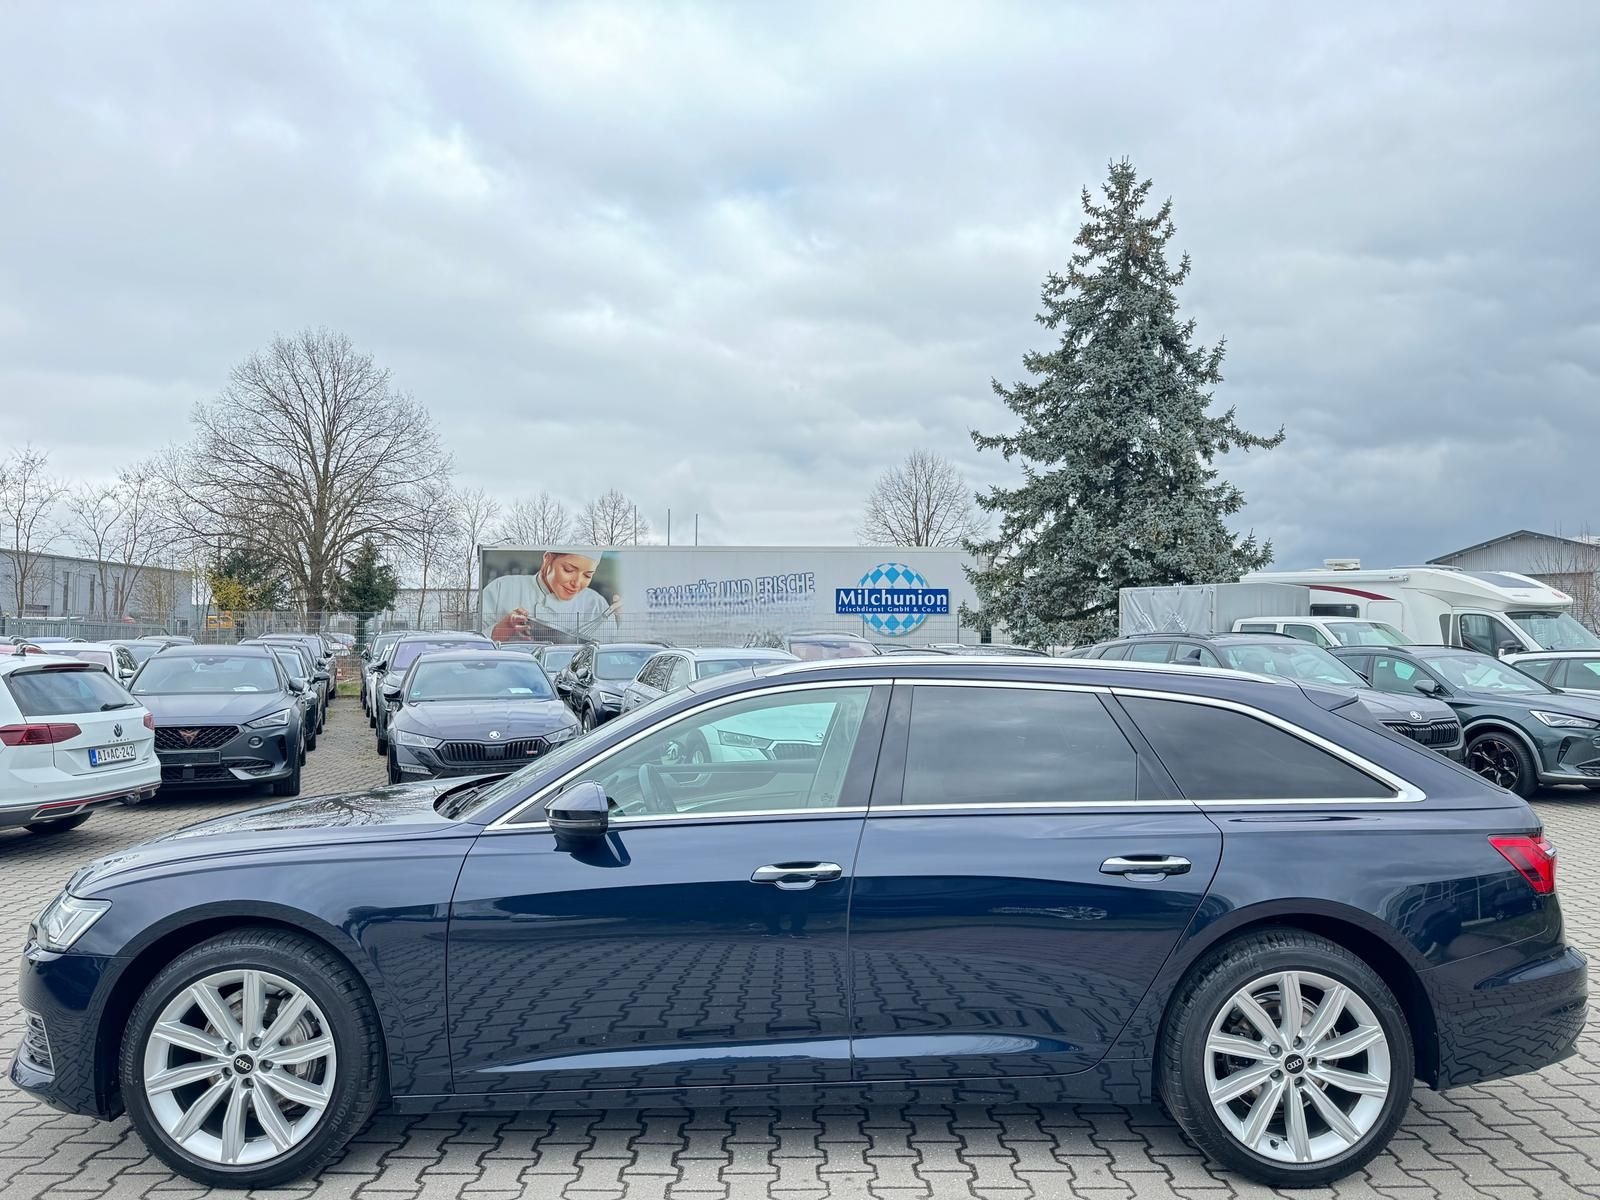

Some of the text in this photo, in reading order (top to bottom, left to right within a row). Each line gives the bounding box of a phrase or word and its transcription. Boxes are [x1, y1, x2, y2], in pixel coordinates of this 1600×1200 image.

[719, 579, 753, 597] UND
[755, 572, 815, 594] FRISCHE
[838, 589, 947, 605] Milchunion
[124, 1002, 152, 1086] BRIDGESTO
